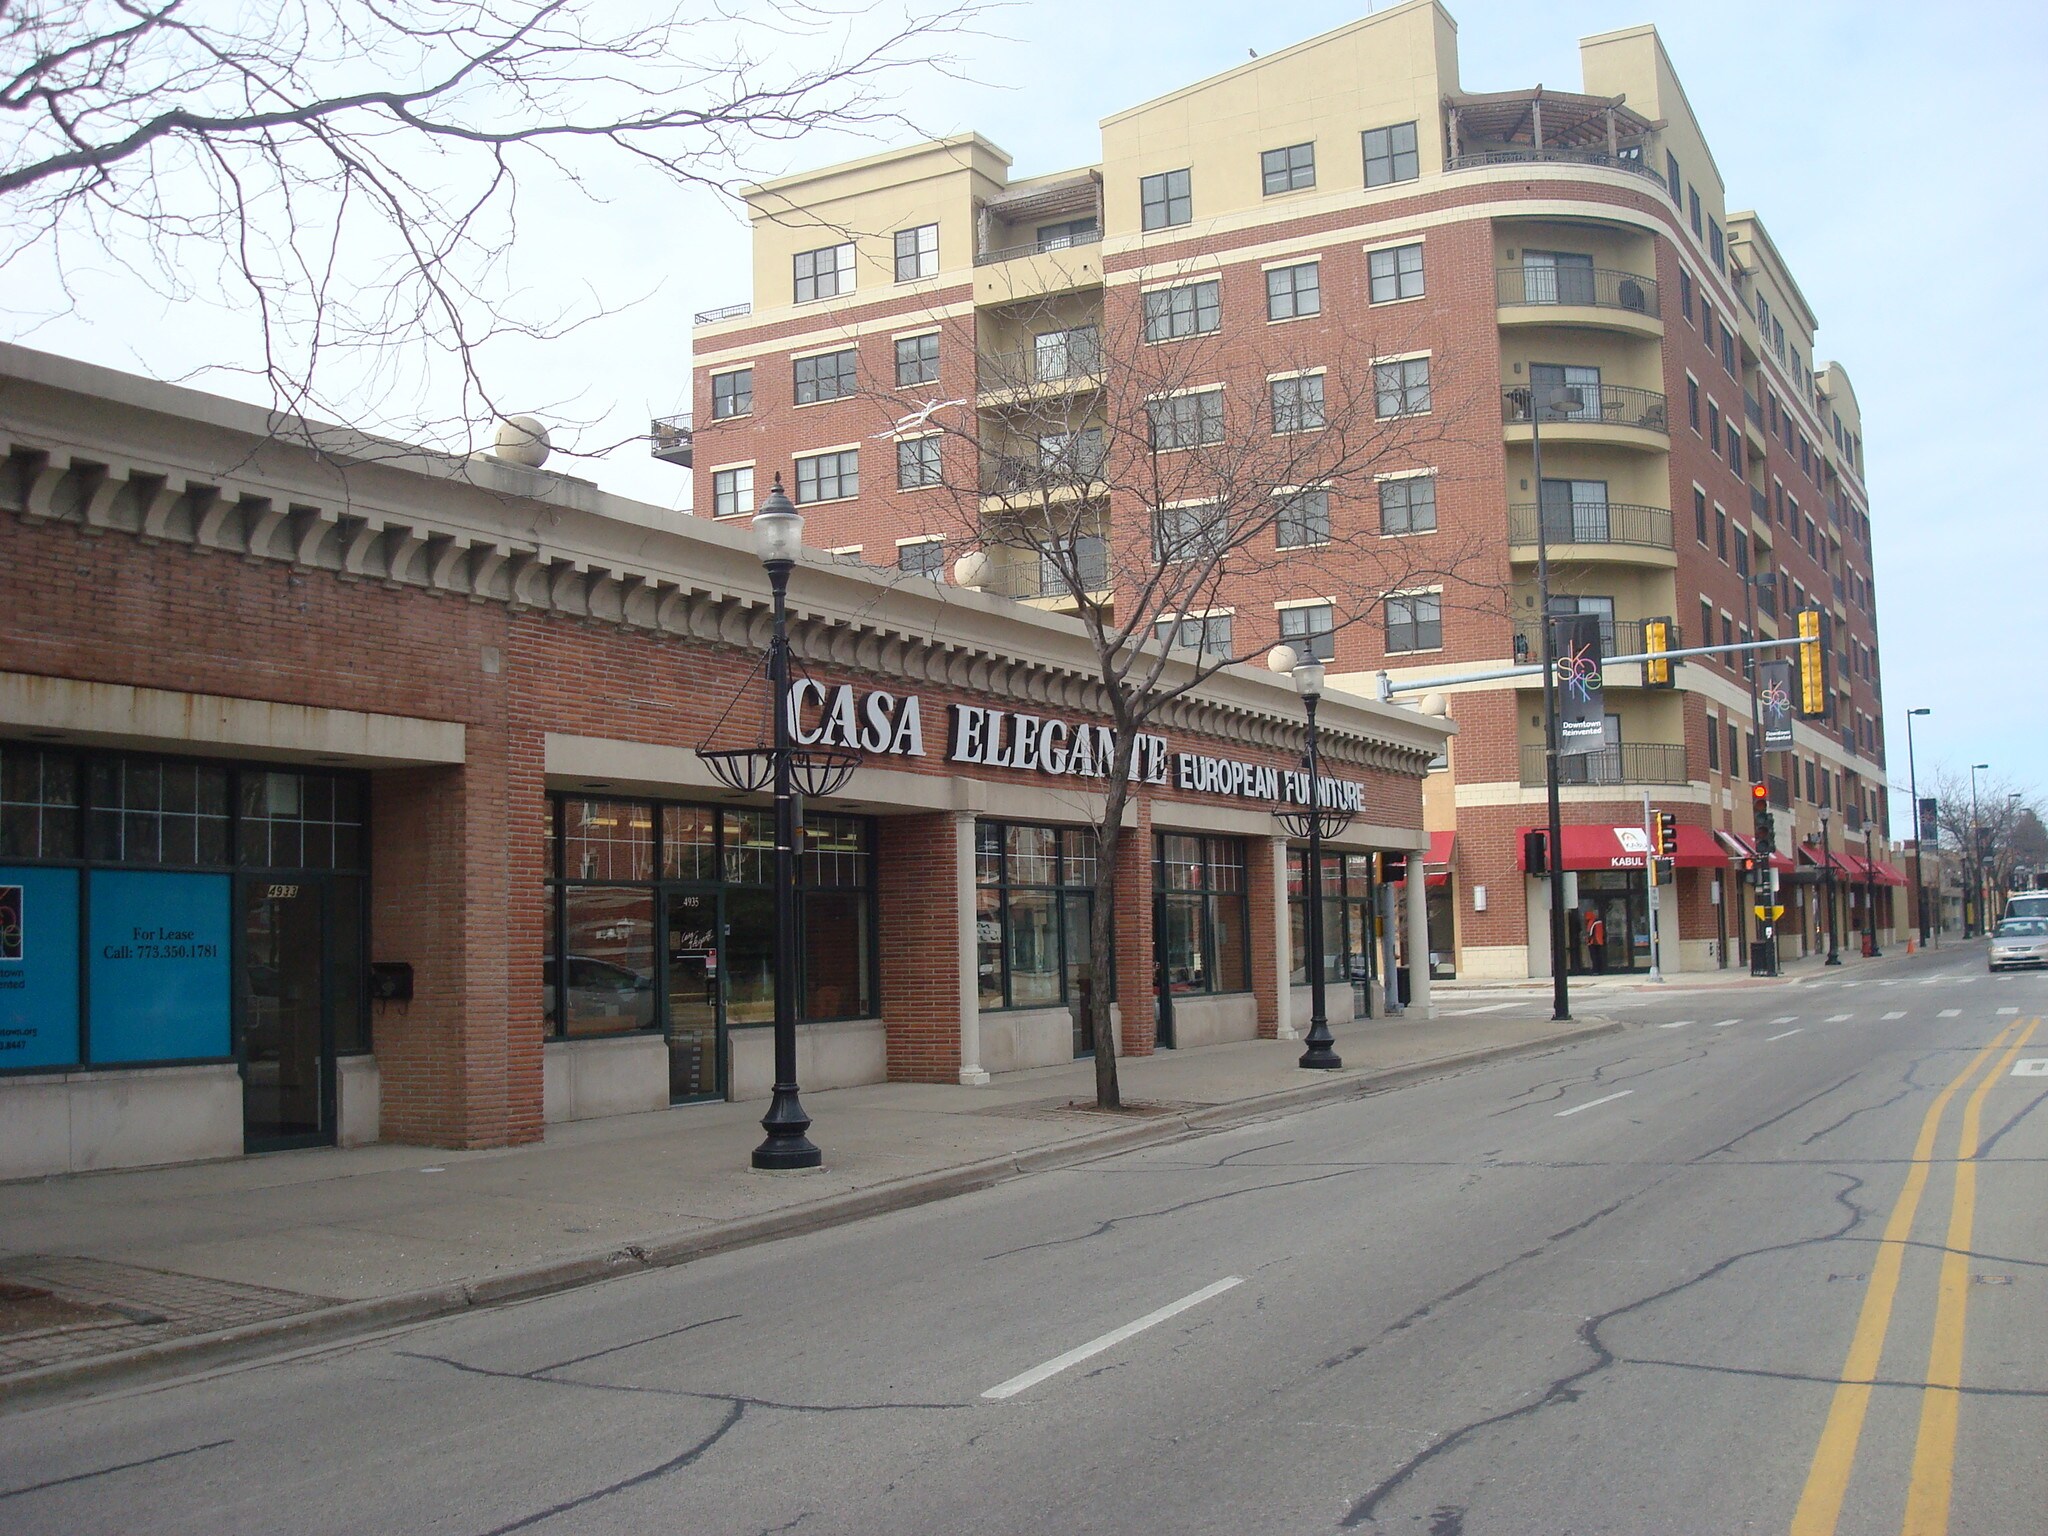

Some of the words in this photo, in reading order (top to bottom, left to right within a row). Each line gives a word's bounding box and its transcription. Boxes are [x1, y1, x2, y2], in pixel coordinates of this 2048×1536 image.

[1562, 720, 1602, 729] Downtown
[1562, 727, 1602, 737] Reinvented
[786, 678, 927, 757] CASA
[951, 703, 1168, 785] ELEGANTE
[1179, 753, 1279, 800] EUROPEAN
[1611, 857, 1643, 867] KABUL
[268, 886, 297, 897] 4933
[683, 896, 699, 907] 4935
[133, 927, 155, 940] For
[159, 927, 194, 940] Lease
[103, 945, 133, 959] Call:
[137, 944, 217, 959] 773.350.1781
